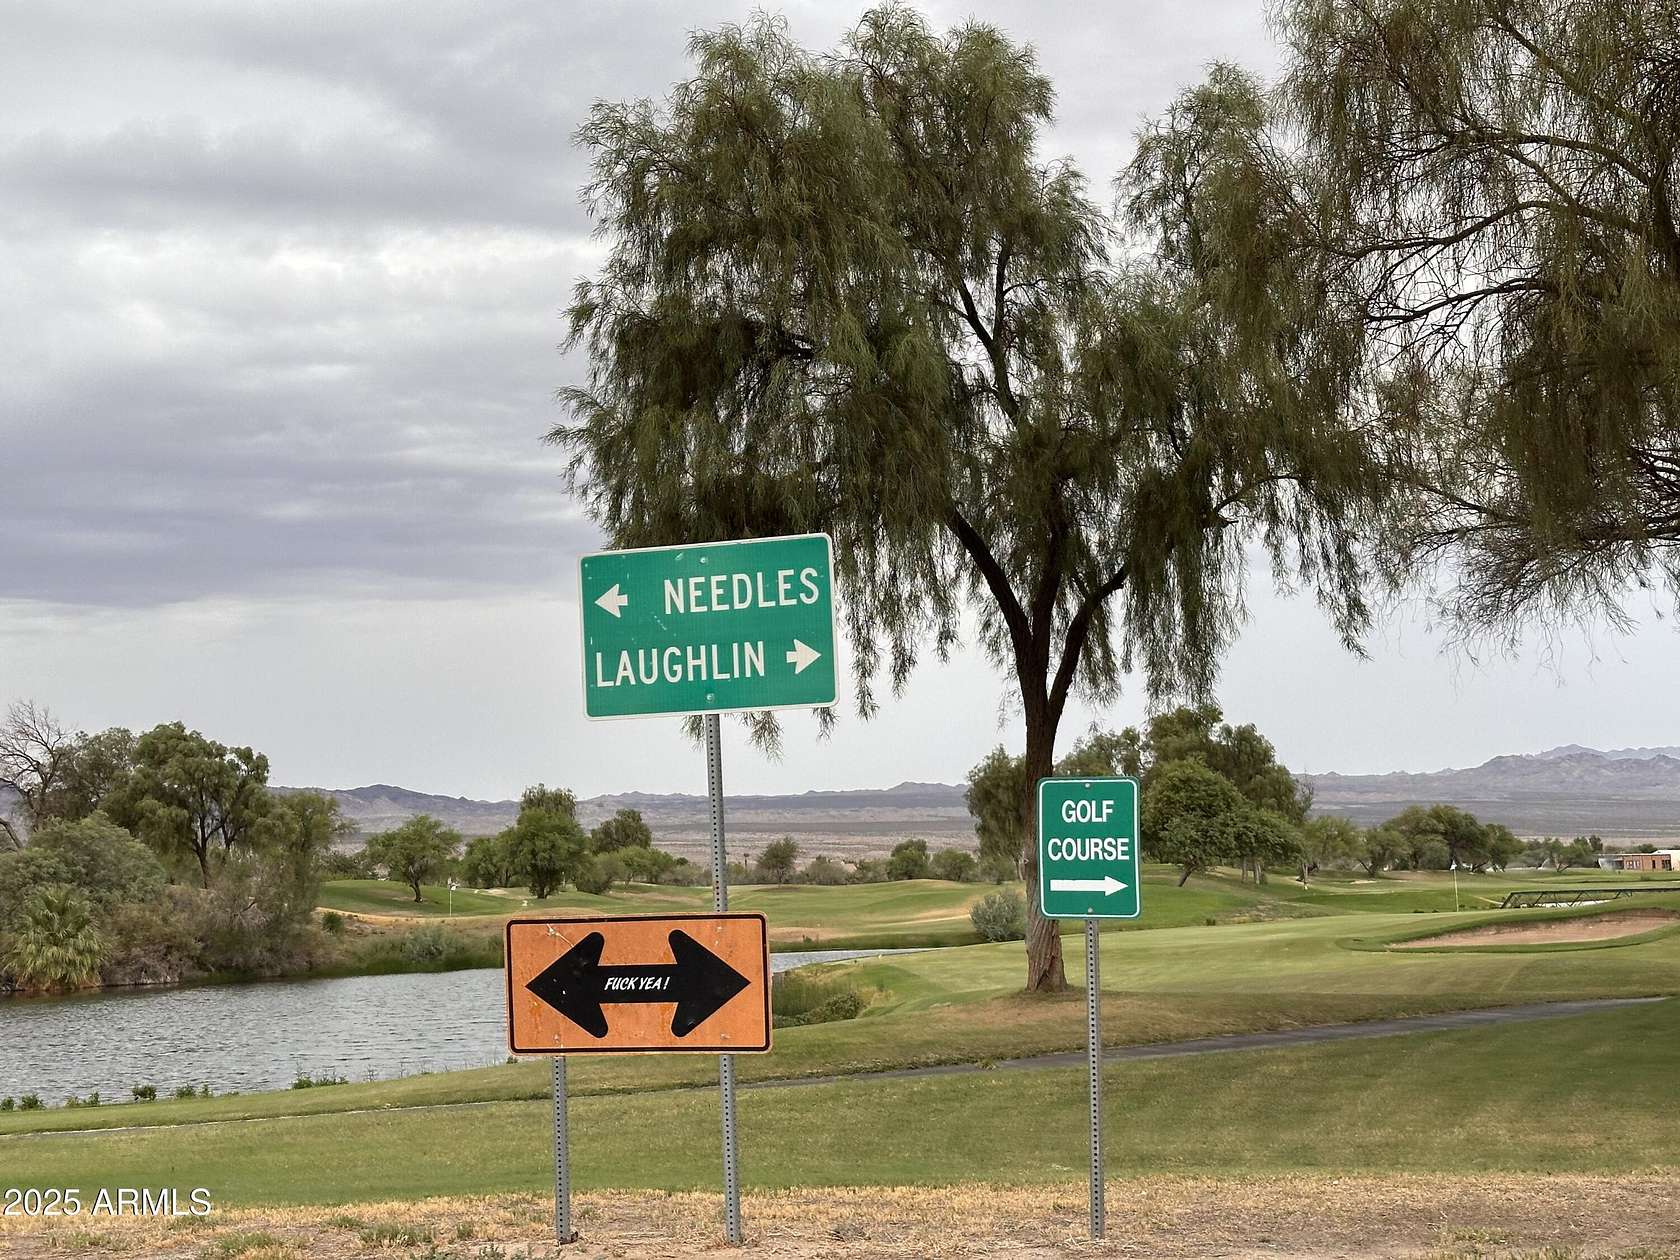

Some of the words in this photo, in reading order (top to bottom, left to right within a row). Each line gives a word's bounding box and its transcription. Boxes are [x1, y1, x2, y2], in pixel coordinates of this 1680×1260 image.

[664, 567, 820, 615] NEEDLES
[596, 641, 765, 688] LAUGHLIN
[1061, 799, 1114, 823] GOLF
[1047, 837, 1130, 861] COURSE
[604, 976, 639, 991] FUCK
